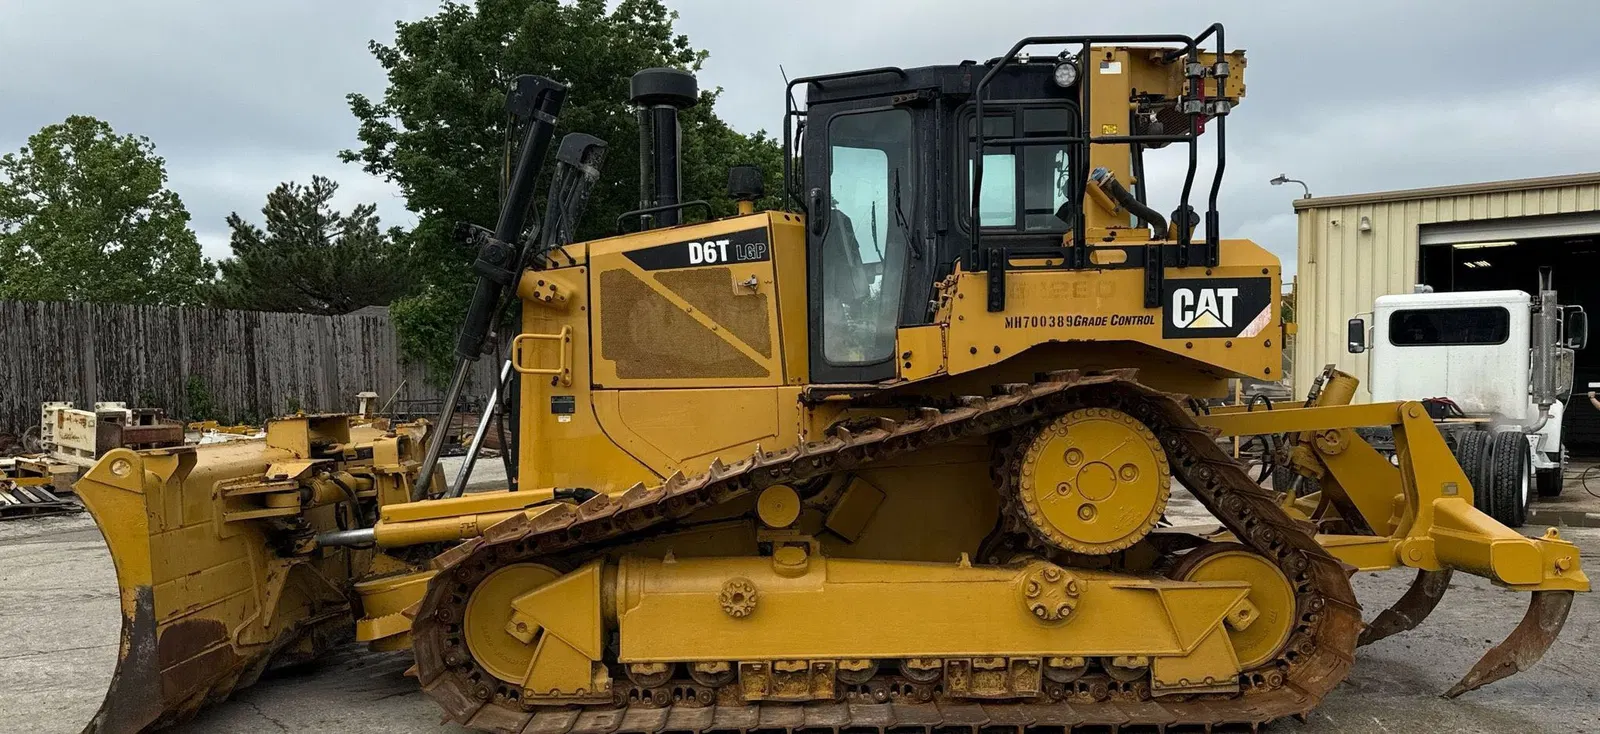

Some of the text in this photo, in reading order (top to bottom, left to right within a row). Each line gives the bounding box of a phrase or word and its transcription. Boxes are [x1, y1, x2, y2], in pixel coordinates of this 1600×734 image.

[688, 239, 767, 264] D6T LGP
[1172, 288, 1239, 329] CAT
[1004, 316, 1073, 329] MH700389
[1073, 314, 1155, 327] GRADE CONTROL
